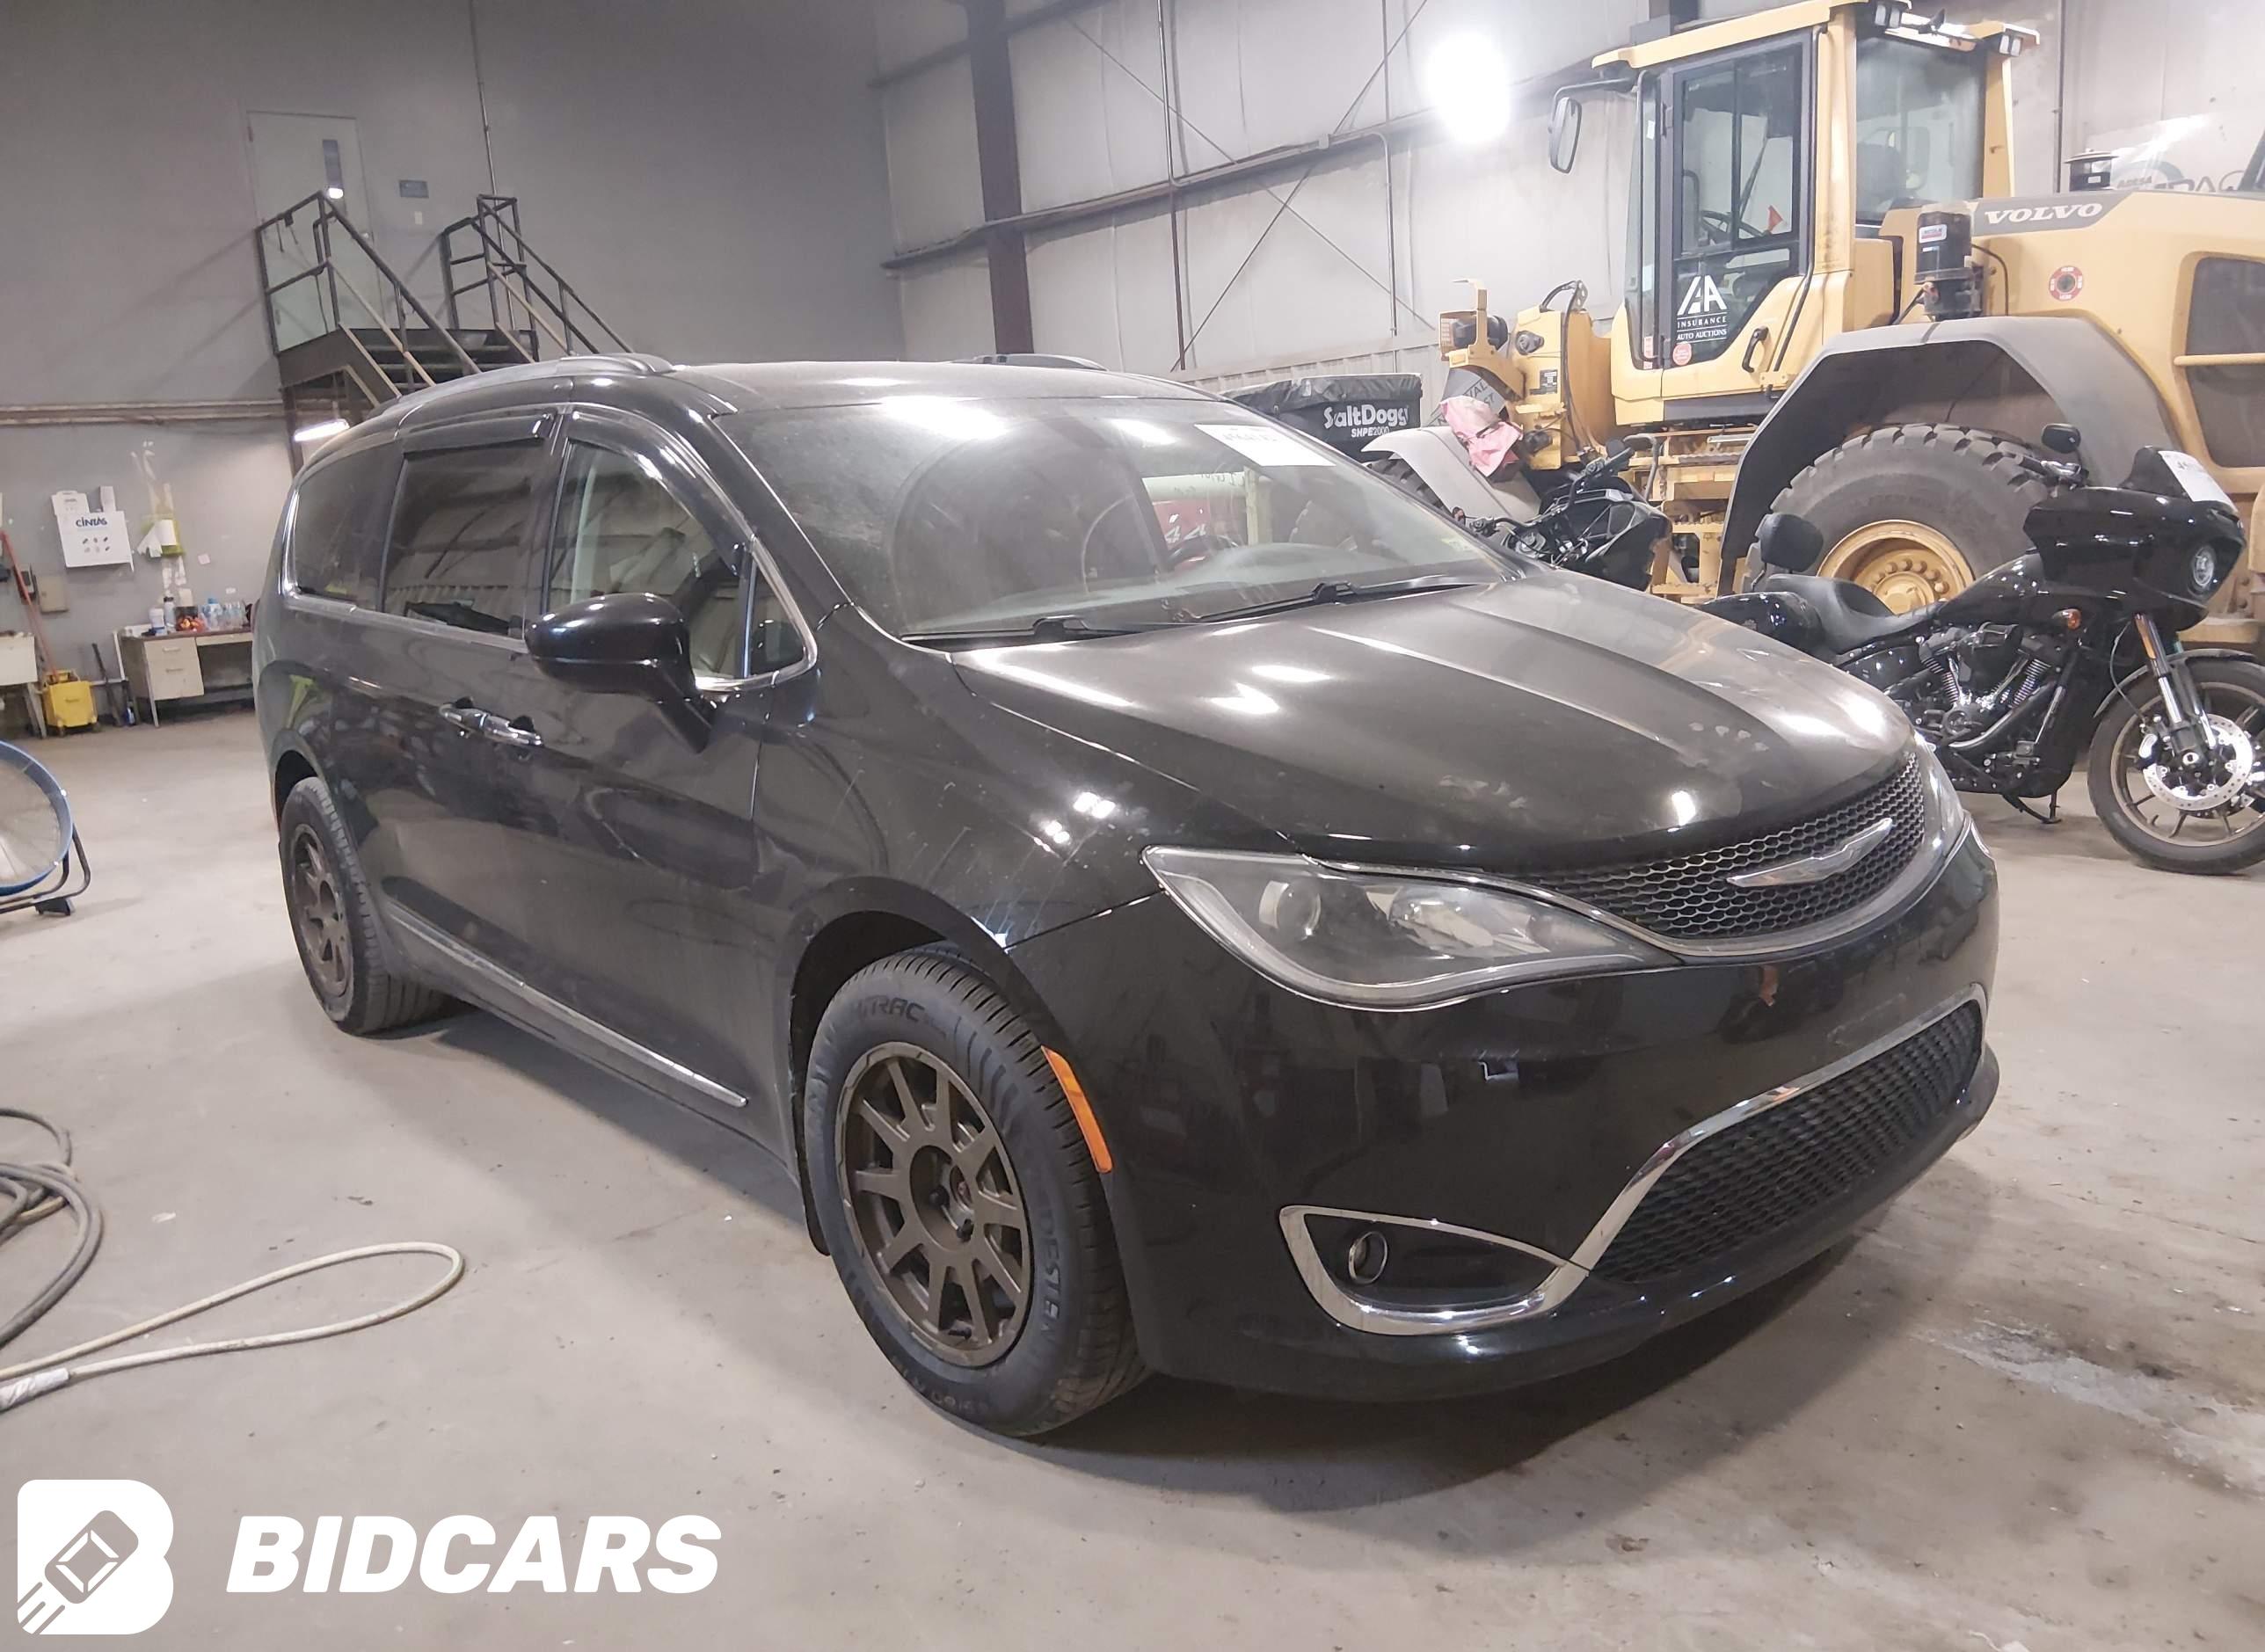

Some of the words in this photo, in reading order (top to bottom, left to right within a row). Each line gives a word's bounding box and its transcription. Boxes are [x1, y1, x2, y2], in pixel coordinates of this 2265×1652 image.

[1985, 203, 2102, 224] VOLVO
[1677, 317, 1728, 329] INSURANCE
[1677, 331, 1694, 341] AUTO
[1695, 329, 1728, 339] AUCTIONS
